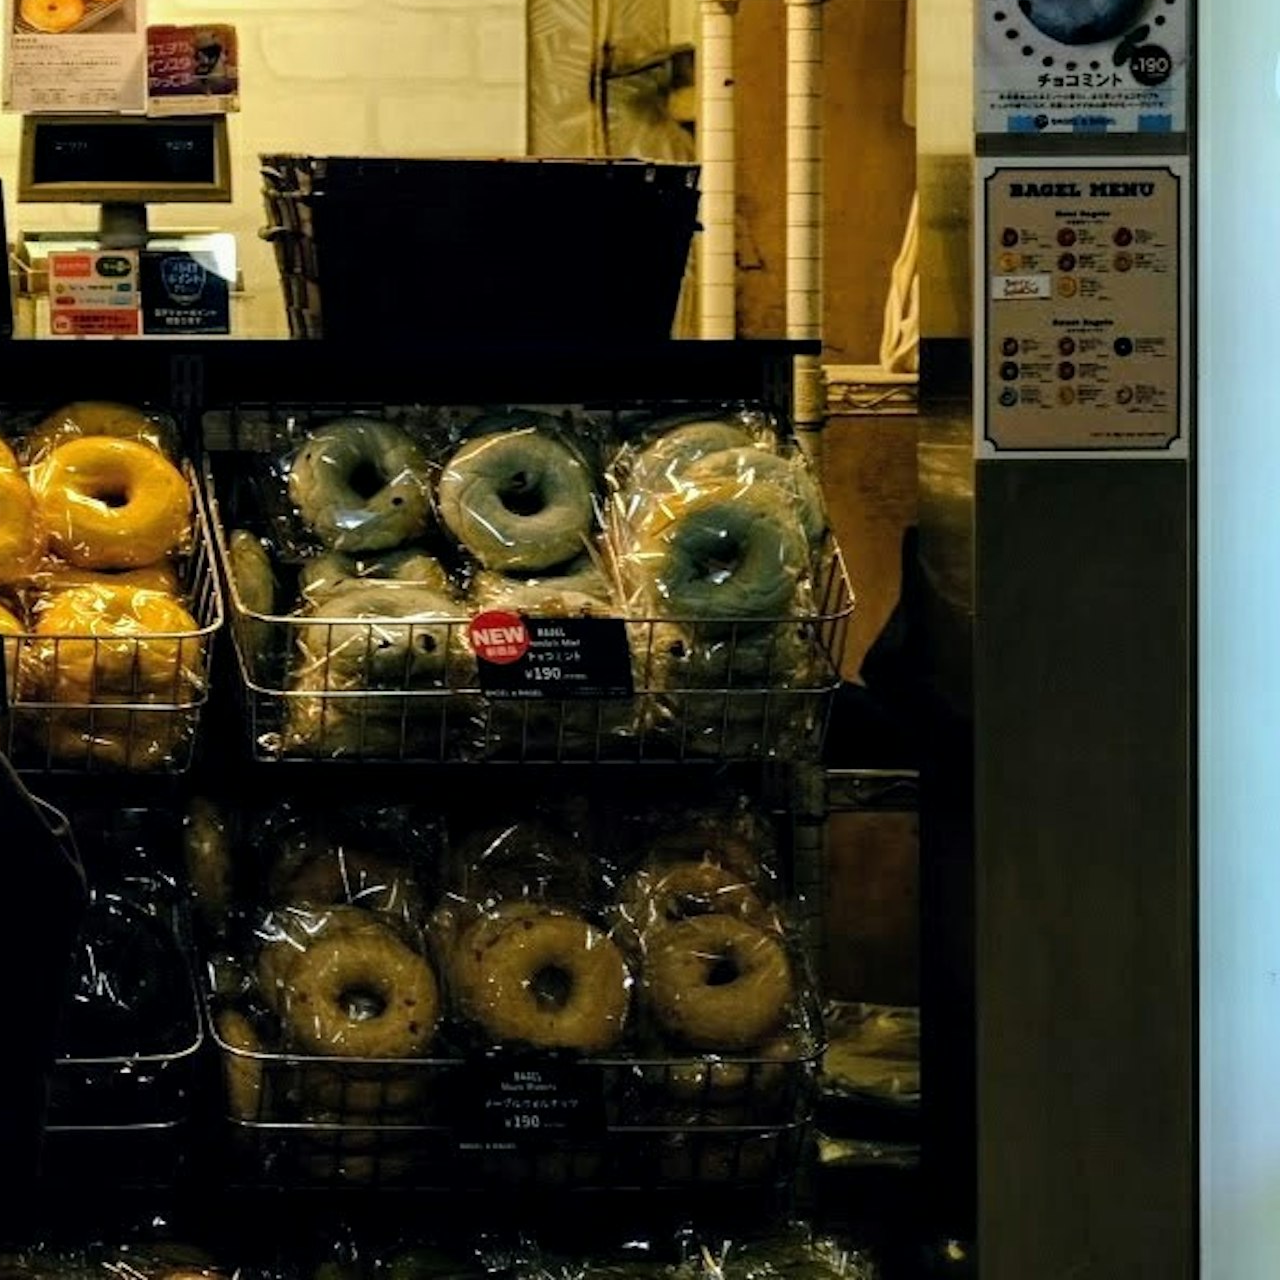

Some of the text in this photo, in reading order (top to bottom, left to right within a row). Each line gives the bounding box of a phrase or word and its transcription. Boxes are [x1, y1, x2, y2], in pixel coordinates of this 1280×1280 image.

[1038, 73, 1122, 87] チョコミント
[1009, 182, 1155, 198] BAGEL MENU
[472, 626, 525, 646] NEW
[525, 667, 561, 680] ¥190
[504, 1114, 541, 1129] ¥190
